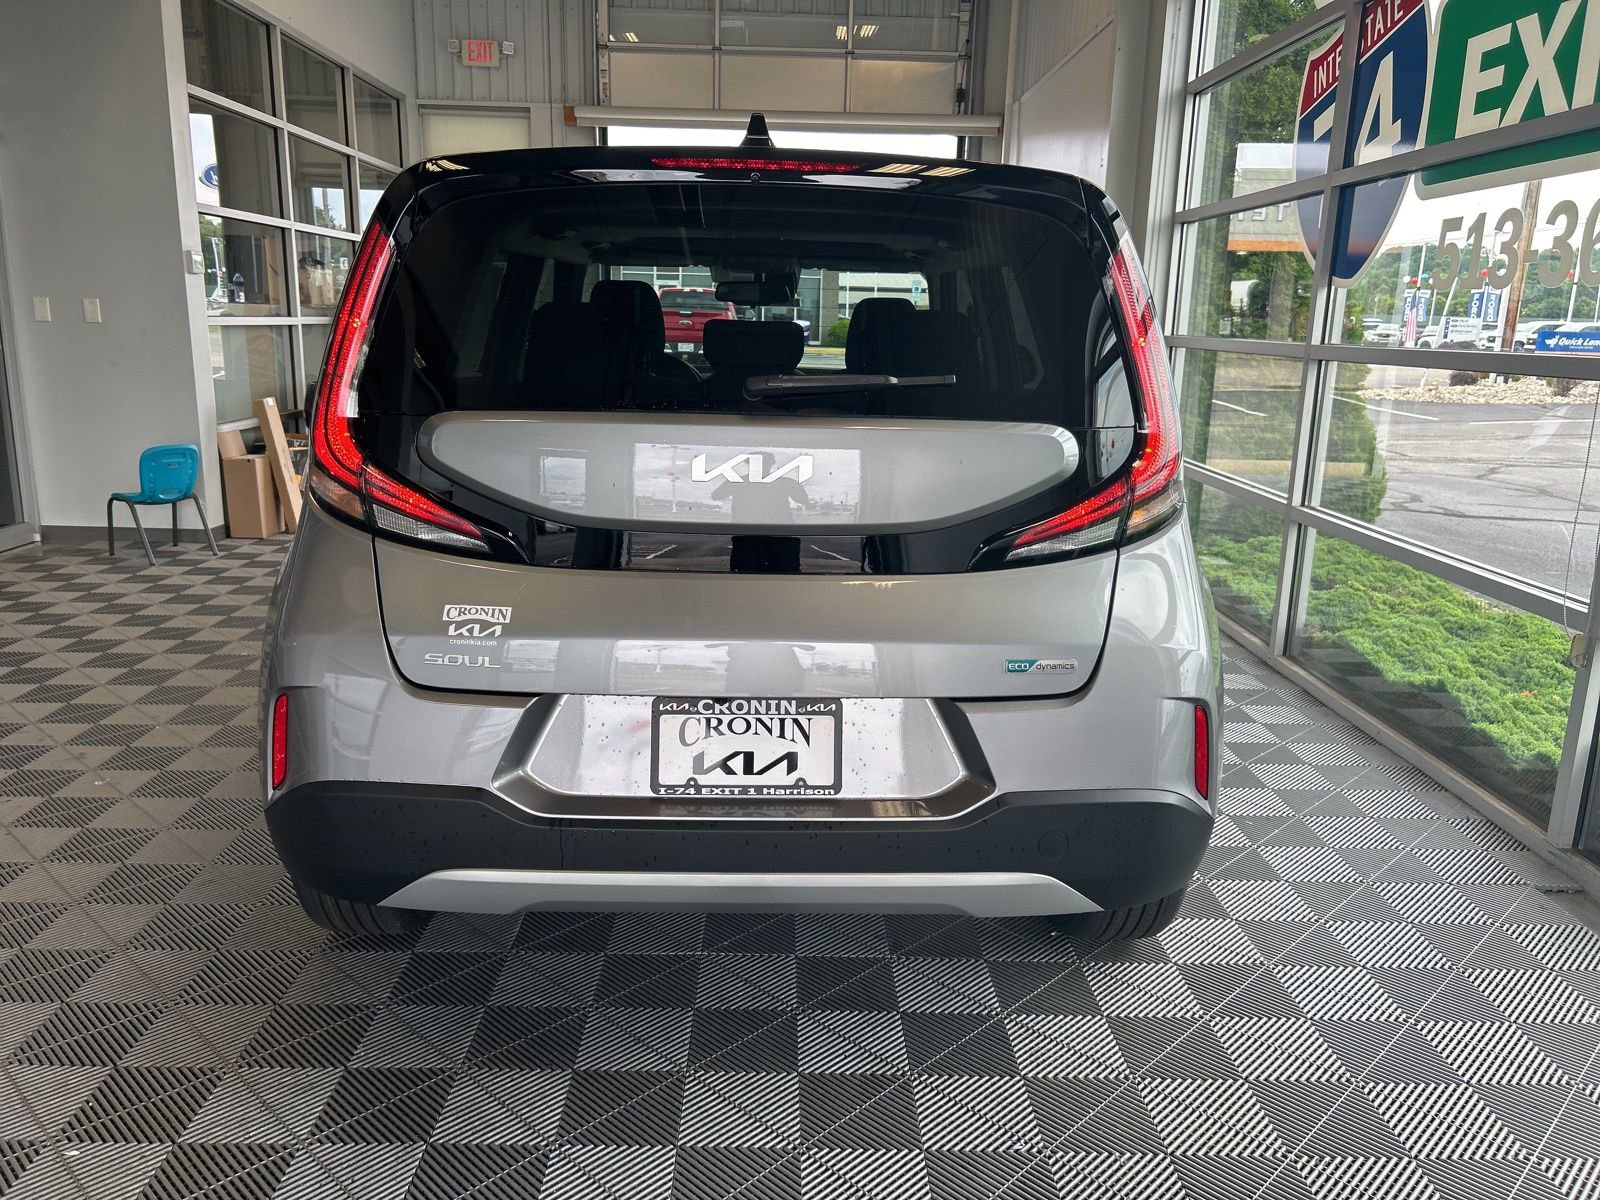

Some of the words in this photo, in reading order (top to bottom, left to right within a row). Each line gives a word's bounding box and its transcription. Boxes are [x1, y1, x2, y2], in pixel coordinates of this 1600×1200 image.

[467, 40, 494, 62] EXIT
[1313, 0, 1404, 99] INTETATE
[1471, 293, 1480, 318] FORD
[1487, 294, 1496, 321] FORD
[1558, 337, 1583, 346] Quick
[691, 453, 813, 484] KIA
[446, 606, 509, 622] CRONIN
[448, 623, 502, 637] KIA
[449, 639, 498, 647] croninkia.com
[424, 653, 502, 668] SOUL
[1008, 662, 1030, 671] ECO
[1035, 662, 1075, 673] dynamics
[659, 703, 689, 711] KIA
[697, 700, 797, 715] CRONIN
[806, 703, 836, 712] KIA
[679, 716, 814, 748] CRONIN
[692, 751, 799, 776] KIA
[659, 787, 697, 795] I-74
[702, 787, 742, 795] EXIT
[748, 787, 758, 795] 1
[762, 787, 835, 795] Harrison
